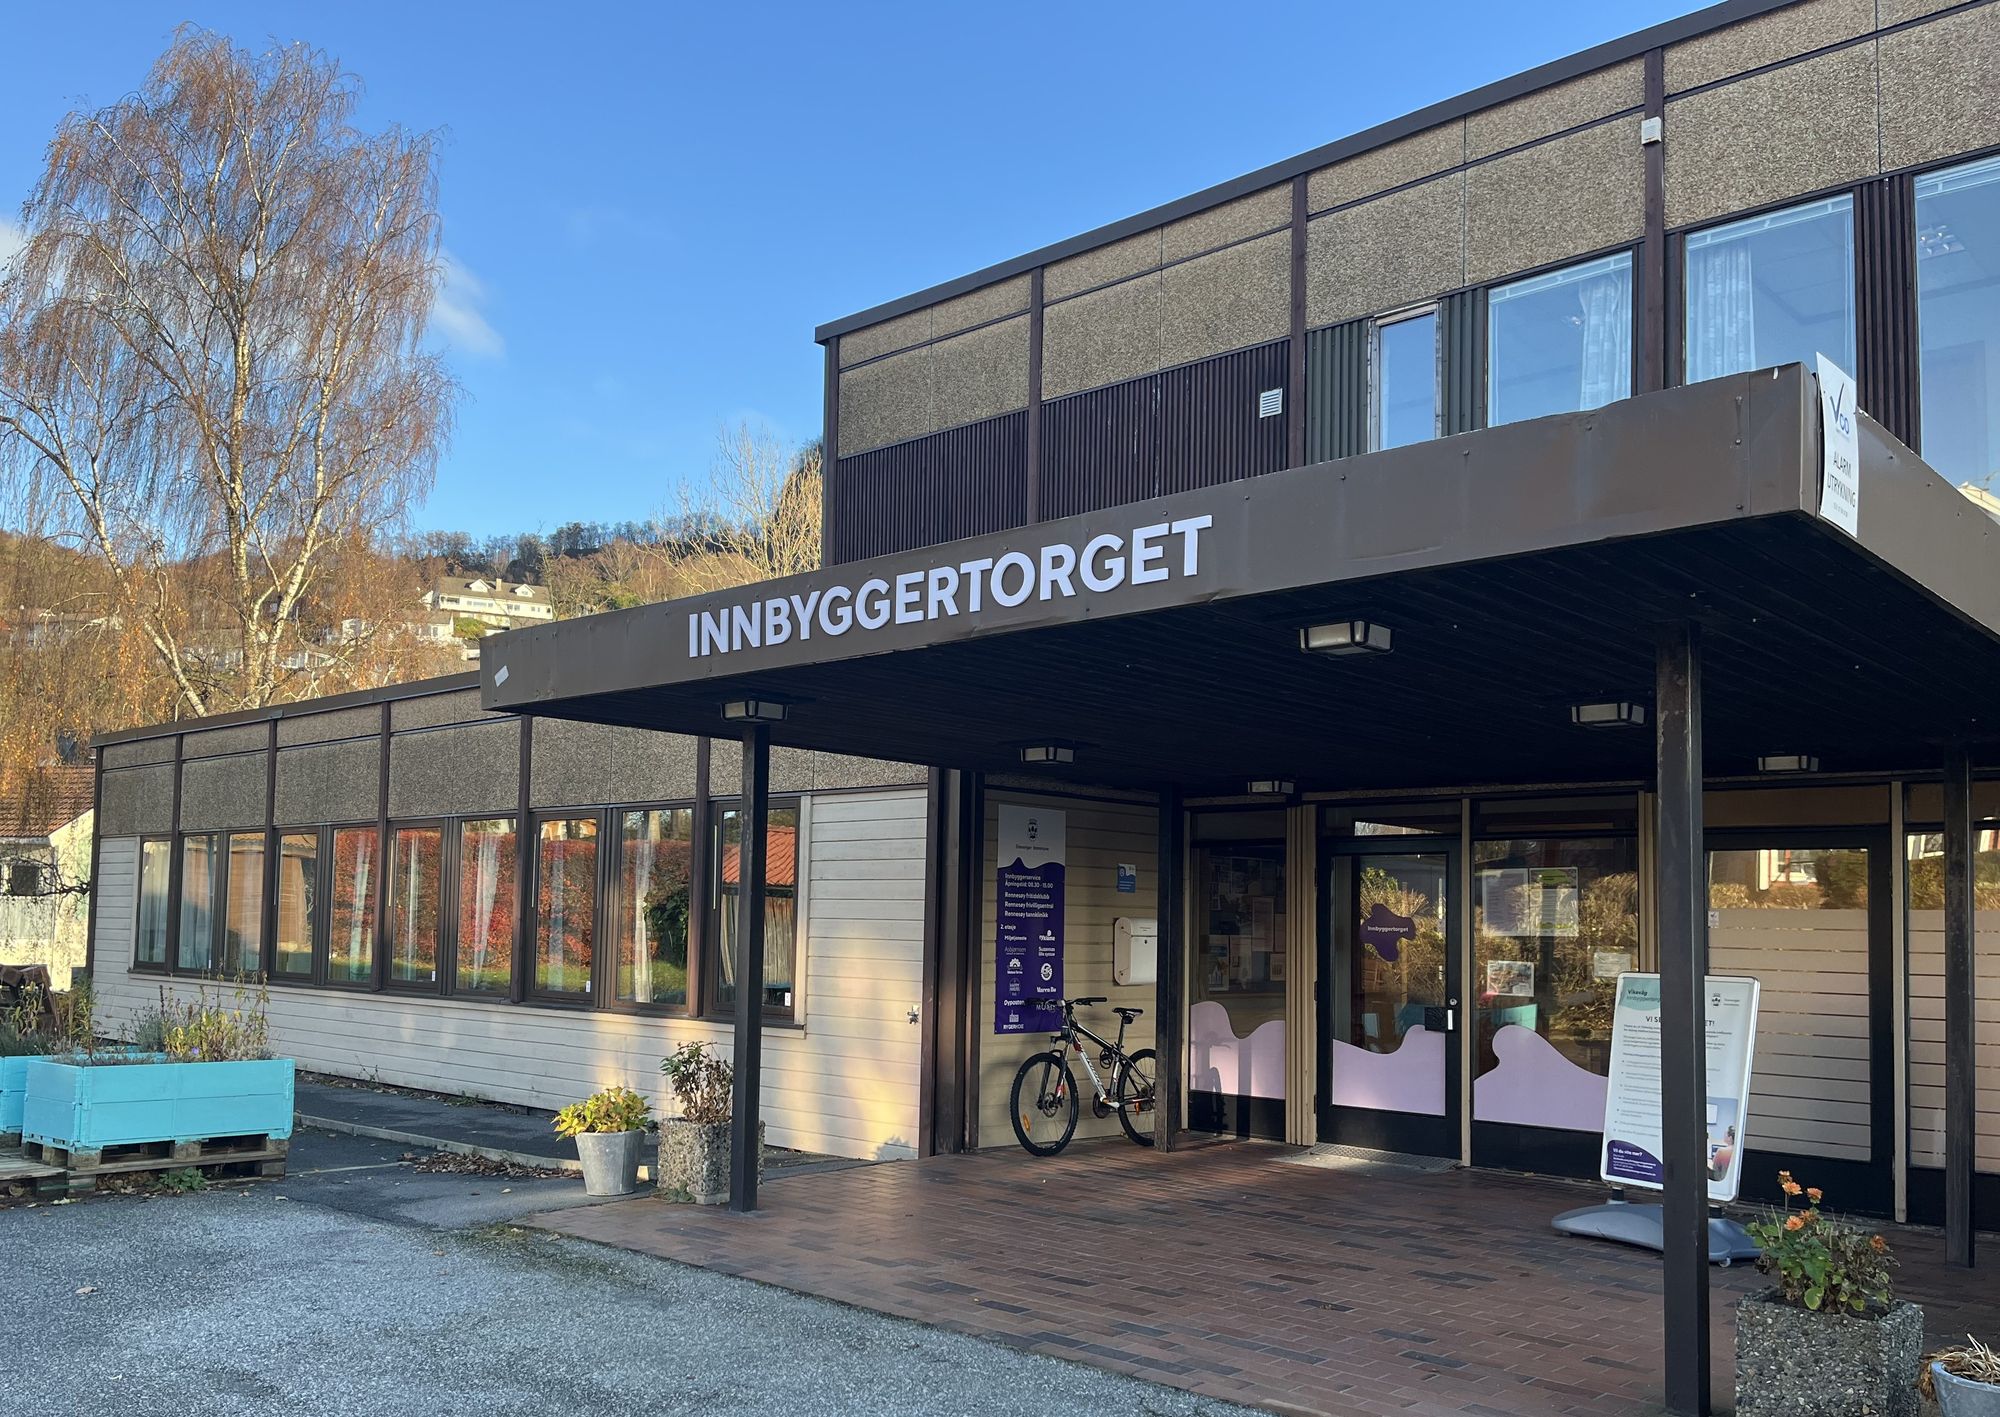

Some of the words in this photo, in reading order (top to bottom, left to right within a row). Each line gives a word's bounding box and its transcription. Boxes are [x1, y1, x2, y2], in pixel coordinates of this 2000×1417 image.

[1832, 451, 1852, 479] ALARM
[1826, 472, 1856, 508] UTRYKNING
[688, 514, 1213, 658] INNBYGGERTORGET
[1645, 1015, 1653, 1023] VI
